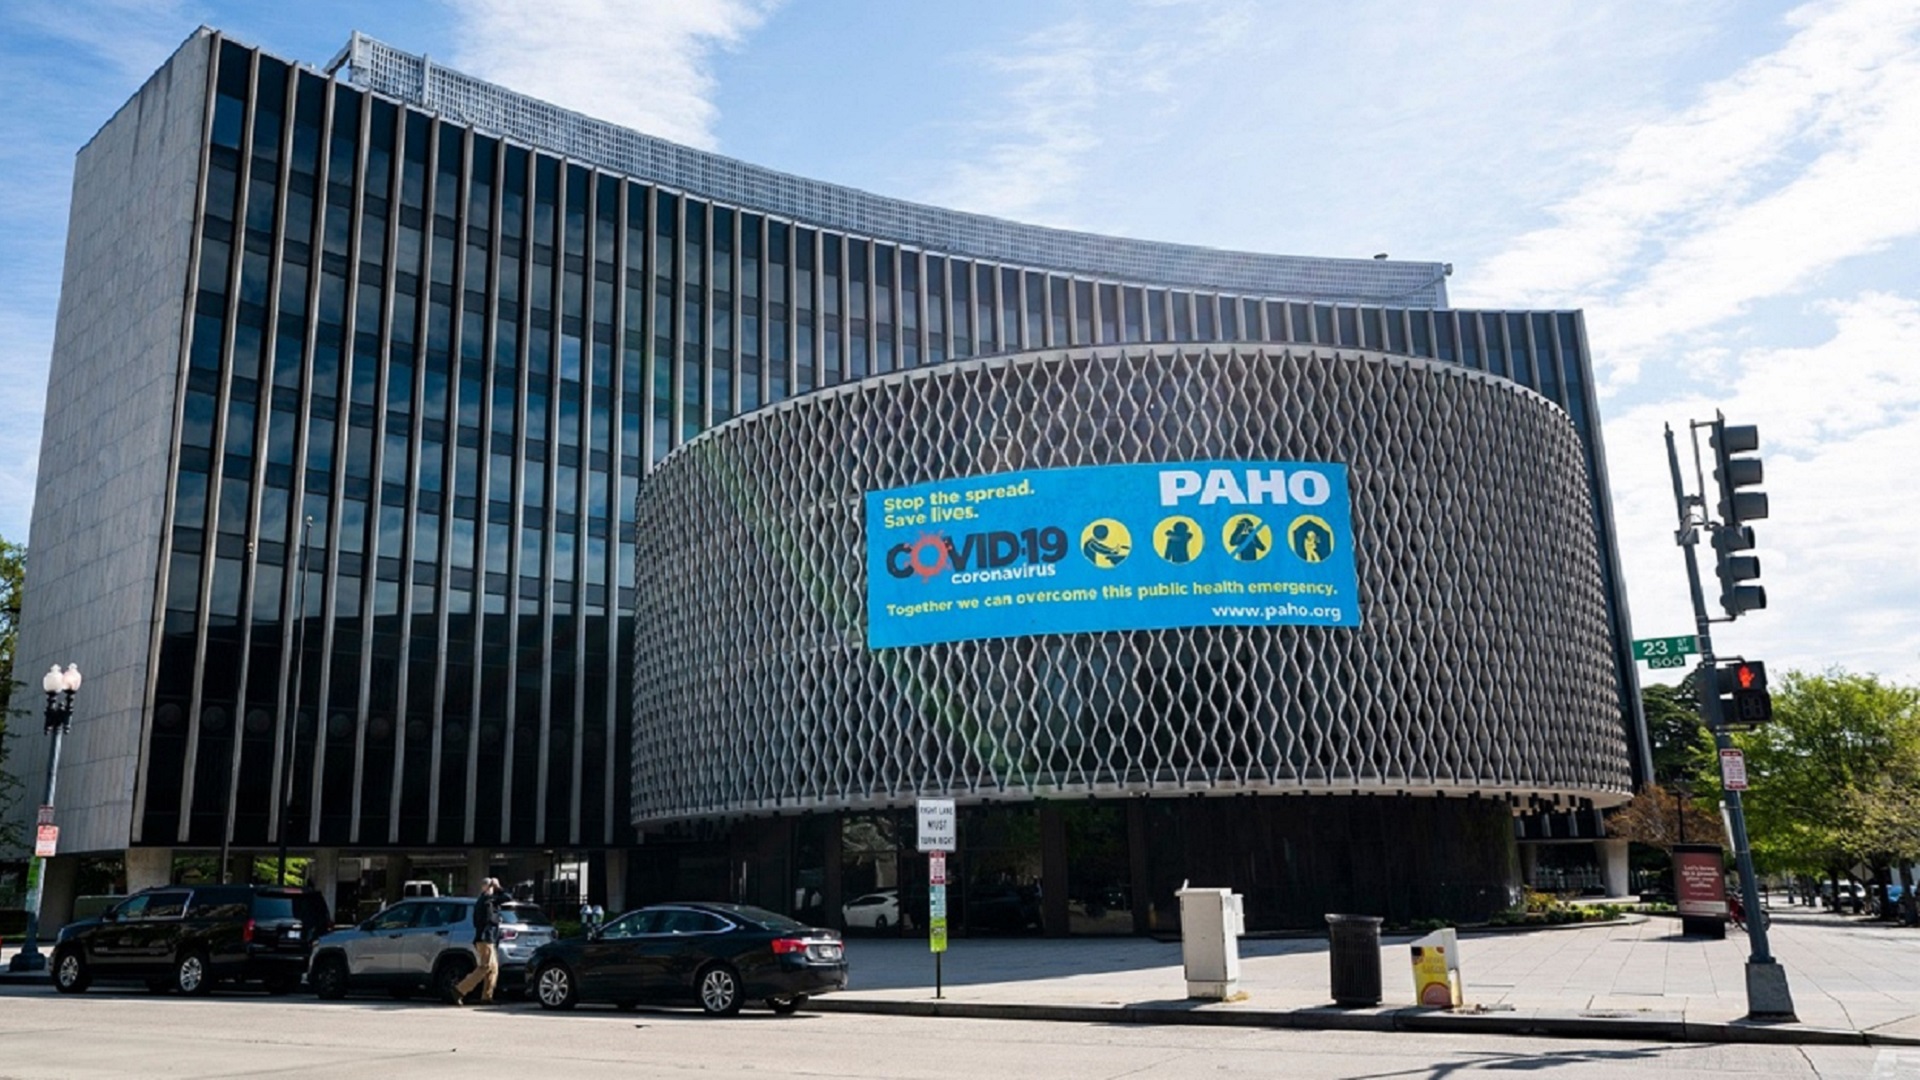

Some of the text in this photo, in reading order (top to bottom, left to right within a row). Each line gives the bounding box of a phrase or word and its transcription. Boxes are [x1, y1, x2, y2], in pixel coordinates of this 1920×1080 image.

[884, 478, 1035, 513] Stop the spread.
[1159, 469, 1331, 506] PAHO
[884, 506, 979, 529] Save lives.
[886, 526, 1068, 579] COVID-19
[951, 563, 1056, 584] coronavirus
[887, 579, 1338, 617] Together we can overcome this public health emergency.
[1212, 602, 1342, 622] www.paho.org
[1642, 641, 1668, 655] 23
[1651, 655, 1683, 668] 500
